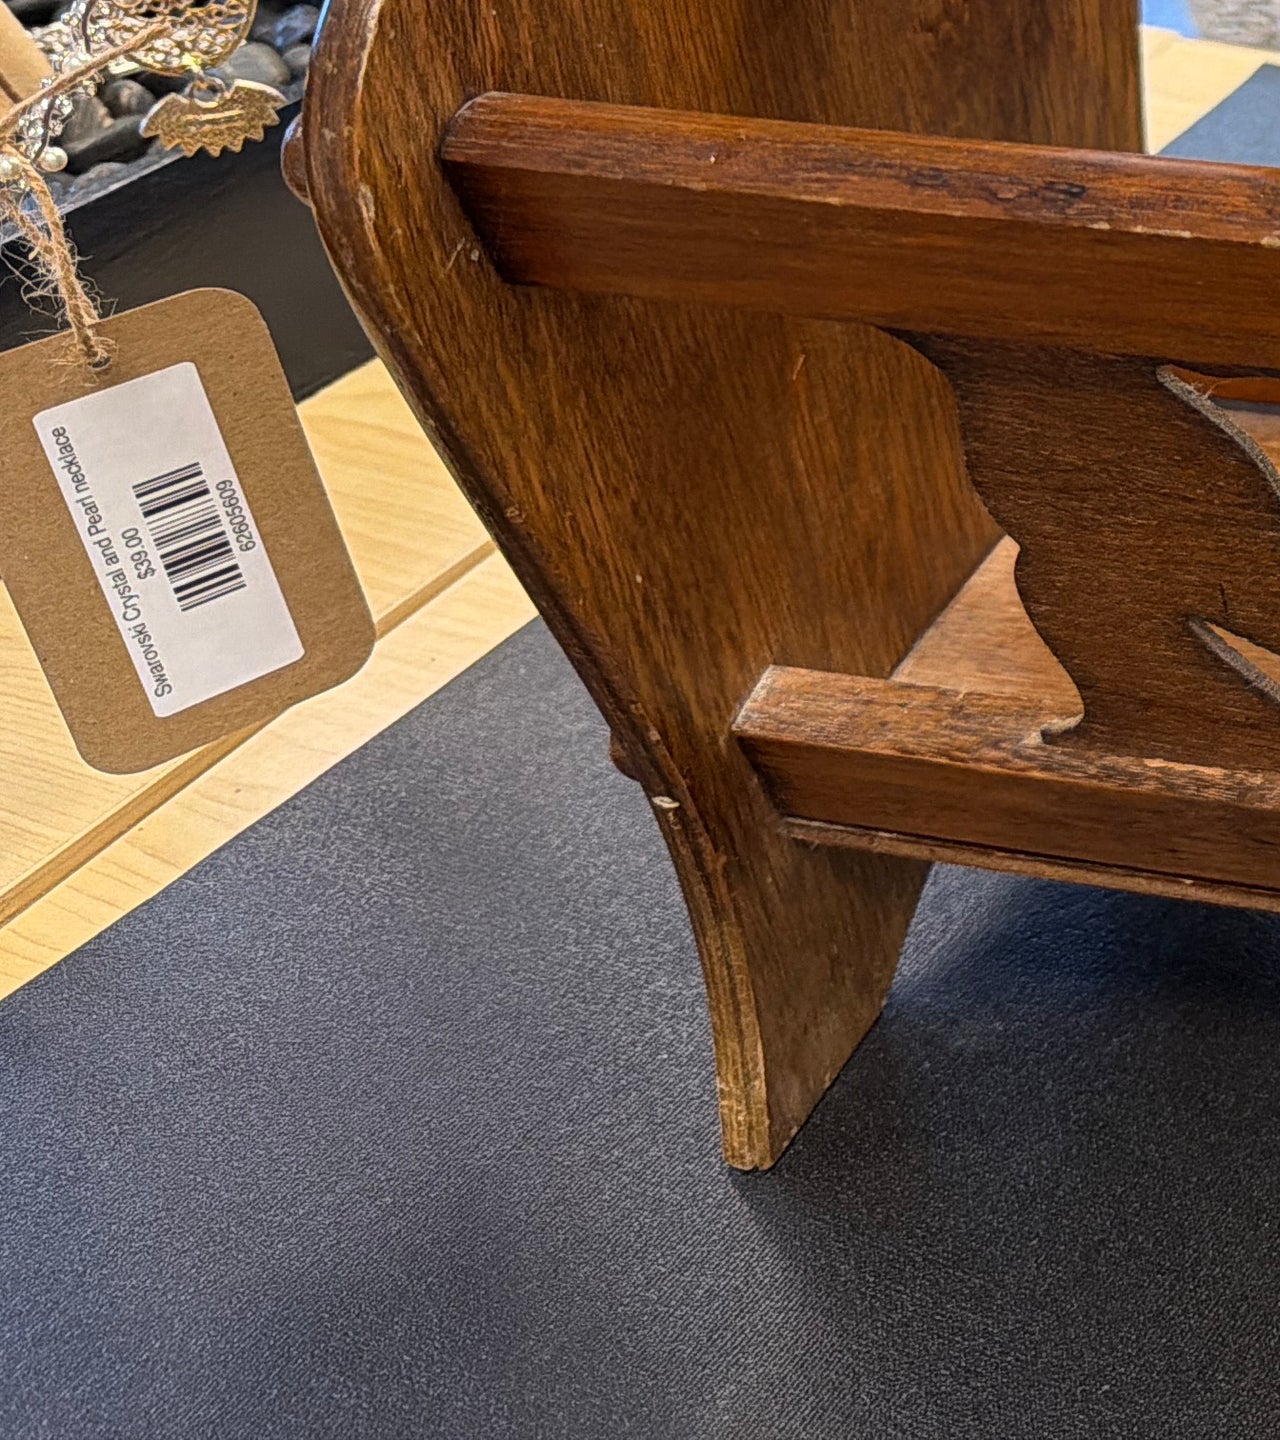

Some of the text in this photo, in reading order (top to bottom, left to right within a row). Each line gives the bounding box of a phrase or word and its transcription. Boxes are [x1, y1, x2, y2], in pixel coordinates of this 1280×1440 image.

[215, 478, 256, 553] 62605609
[51, 425, 173, 698] Swarovski Crystal and Pearl necklace
[120, 527, 157, 580] $39.00
